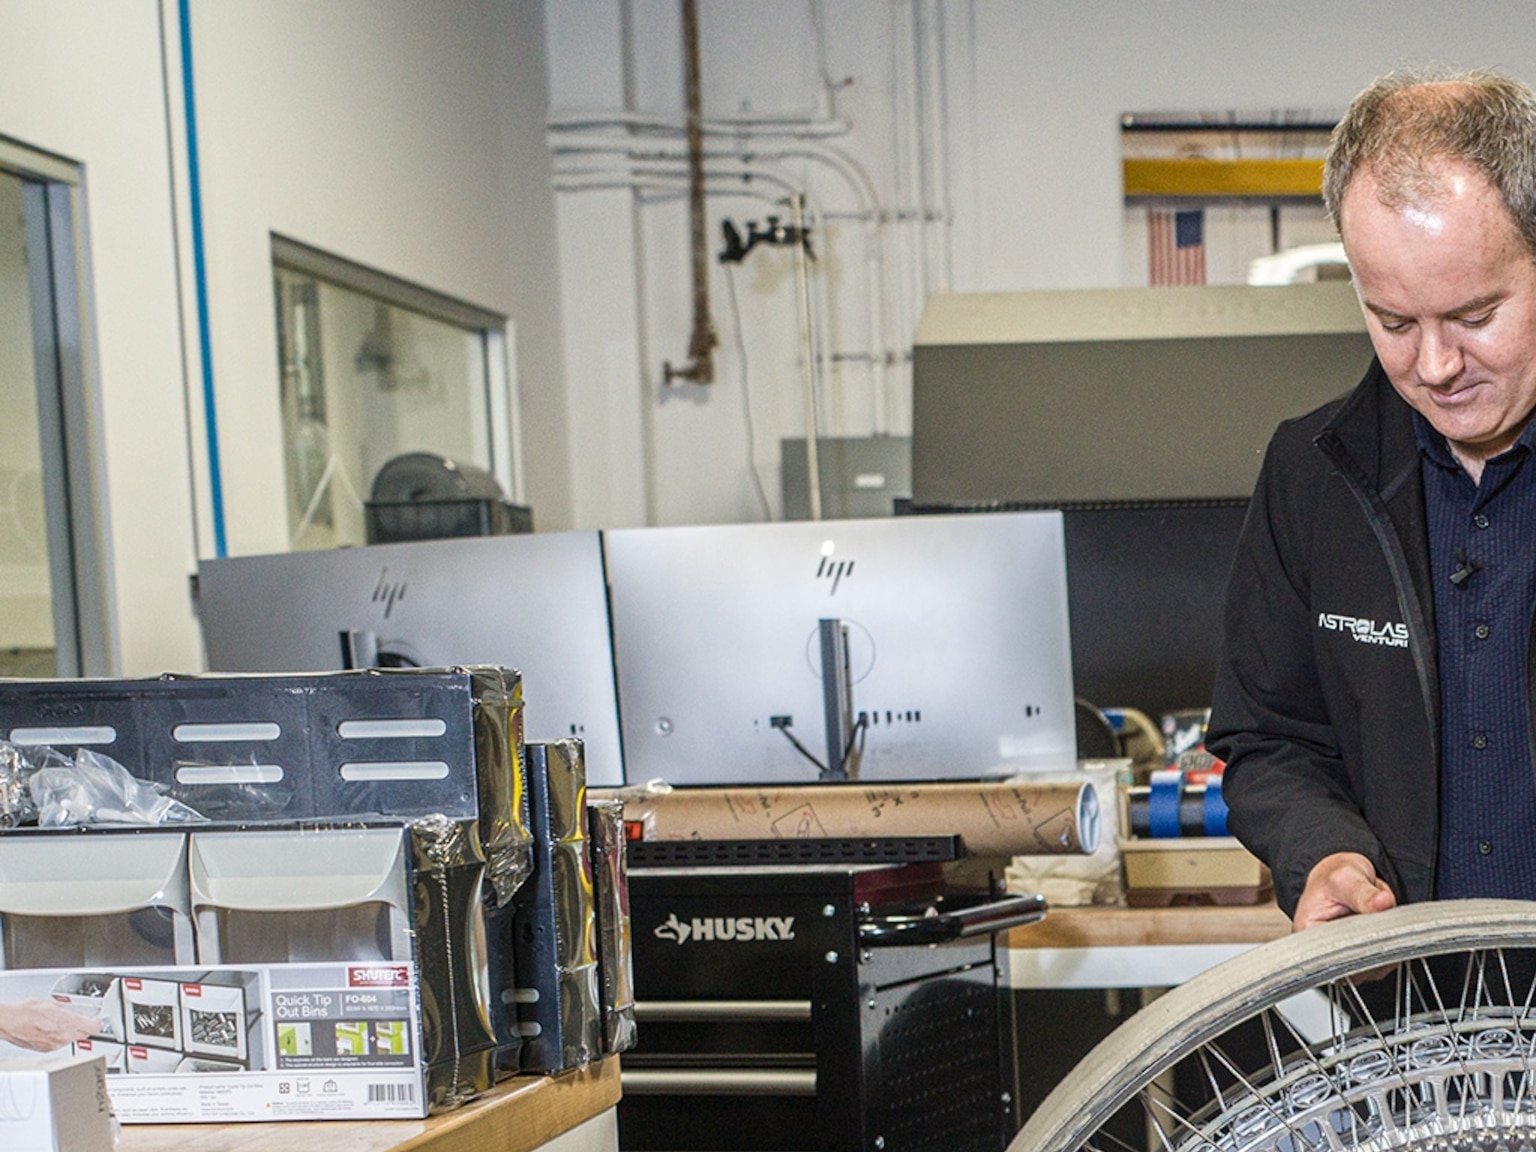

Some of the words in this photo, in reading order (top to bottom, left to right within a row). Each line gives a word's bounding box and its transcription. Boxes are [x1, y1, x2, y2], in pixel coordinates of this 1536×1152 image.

[372, 567, 407, 619] hp
[691, 916, 795, 942] HUSKY
[276, 994, 311, 1007] Quick
[313, 994, 332, 1008] Tip
[276, 1006, 300, 1018] Out
[301, 1005, 328, 1018] Bins
